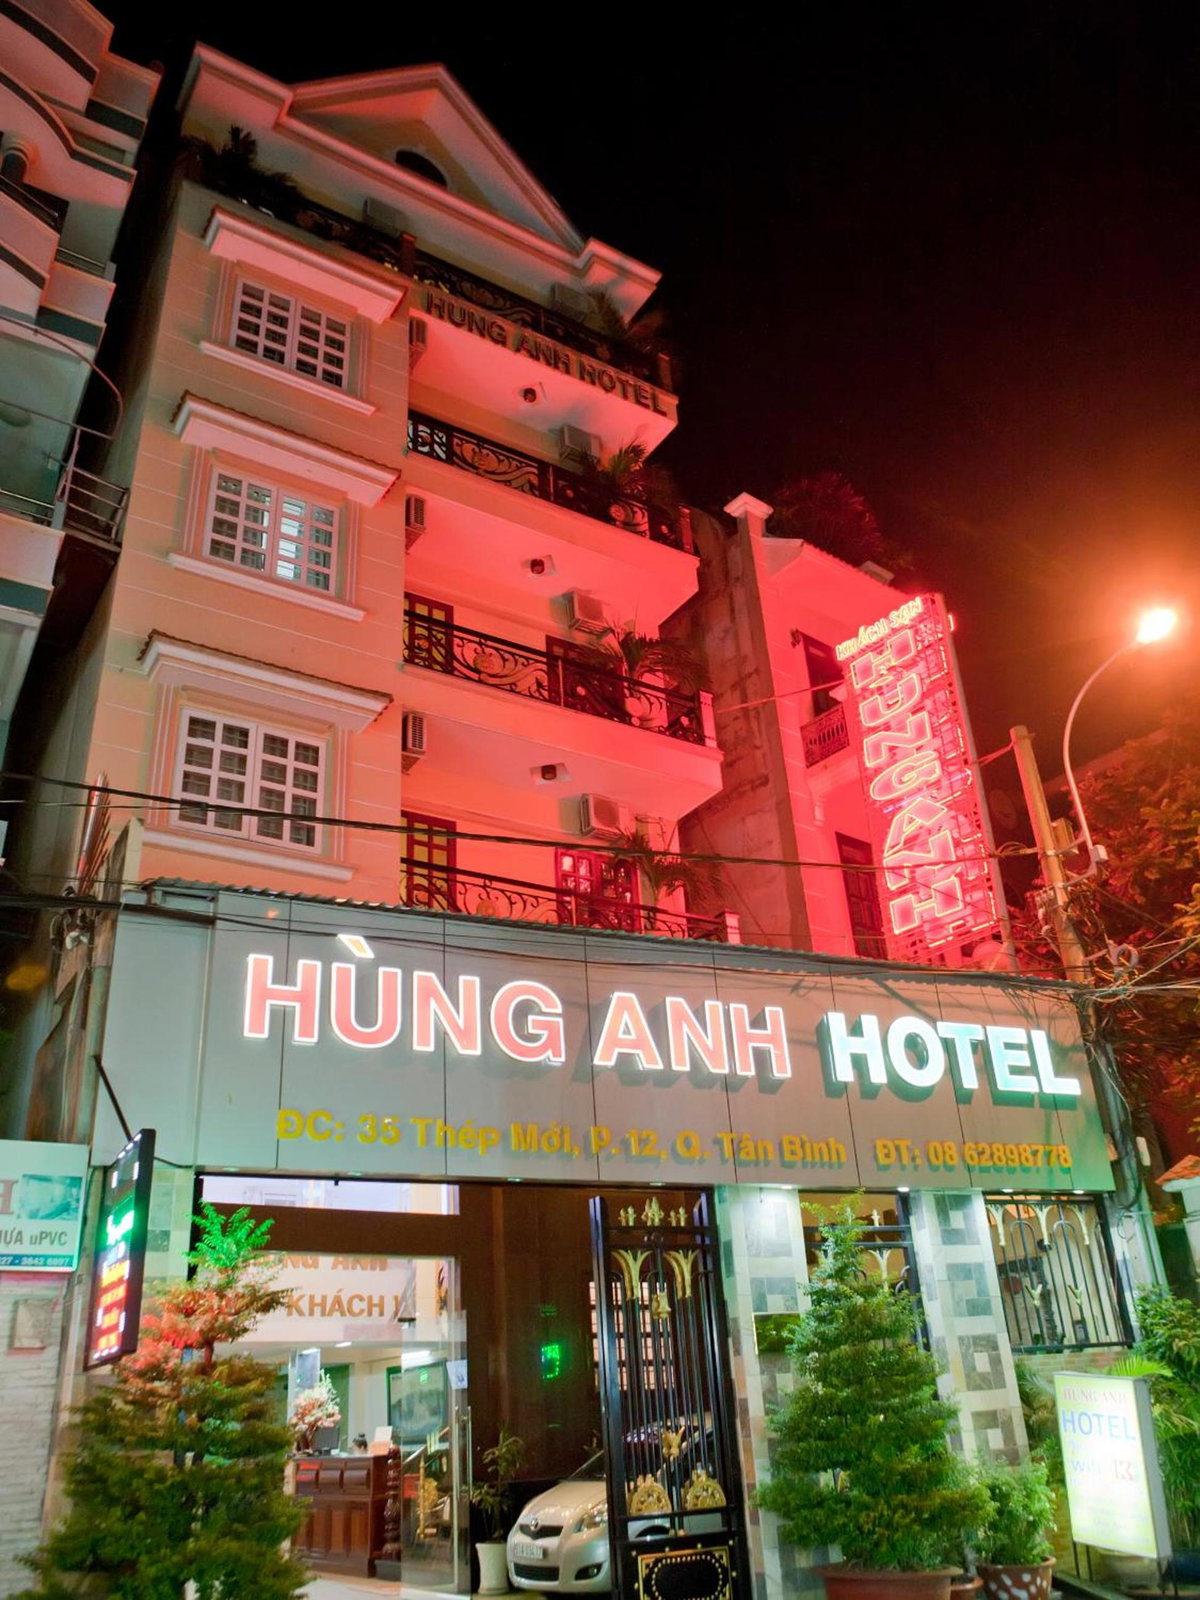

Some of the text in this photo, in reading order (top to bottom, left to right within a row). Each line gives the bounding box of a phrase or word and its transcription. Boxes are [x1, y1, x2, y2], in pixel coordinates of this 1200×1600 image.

[513, 330, 571, 375] ANH
[577, 356, 668, 417] HOTEL
[883, 797, 962, 934] ANH
[243, 934, 1081, 1097] HÙNG ANH HOTEL
[276, 1109, 344, 1142] ĐC:
[357, 1114, 401, 1146] 35
[410, 1117, 499, 1155] Thép
[511, 1121, 580, 1158] Mới,
[676, 1130, 712, 1159] Q.
[717, 1132, 775, 1161] Tân
[780, 1134, 848, 1162] Bình
[875, 1138, 922, 1165] ĐT:
[927, 1141, 959, 1166] 08
[963, 1142, 1072, 1169] 62898778
[287, 1288, 384, 1317] KHÁCH
[1061, 1409, 1137, 1441] HOTEL
